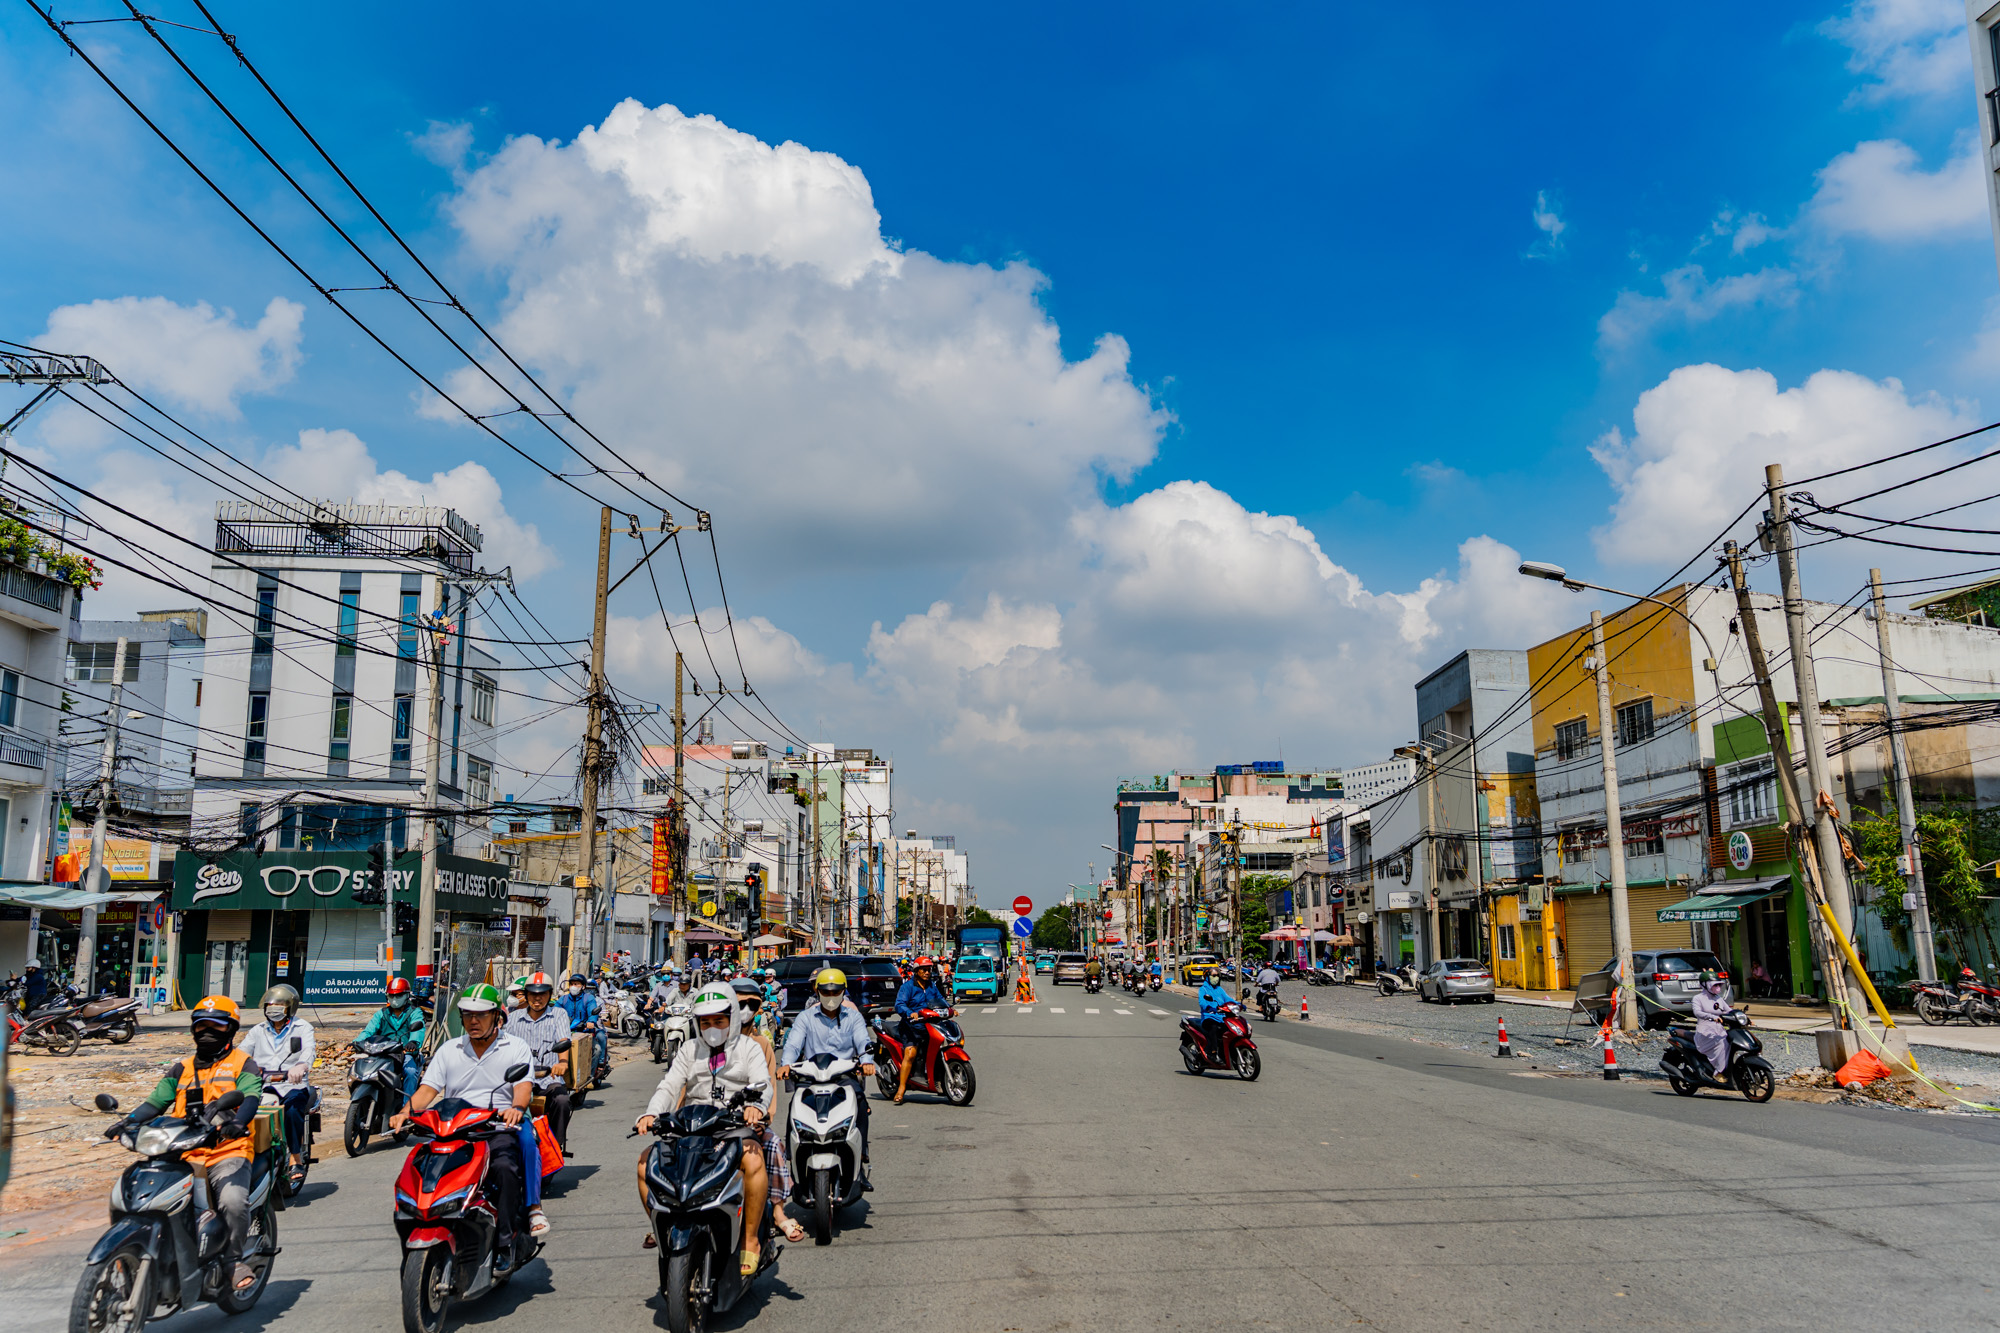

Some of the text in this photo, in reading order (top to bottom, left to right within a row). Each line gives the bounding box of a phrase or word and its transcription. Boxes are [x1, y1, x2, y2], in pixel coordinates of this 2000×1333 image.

[1254, 822, 1287, 830] KHOA
[110, 849, 145, 858] MOBILE
[1731, 846, 1749, 861] 308
[193, 864, 243, 900] Seen
[456, 873, 487, 897] GLASSES
[489, 920, 511, 928] ZEISS
[352, 978, 366, 986] LÂU
[306, 987, 320, 995] BẠN
[360, 985, 377, 994] KÍNH
